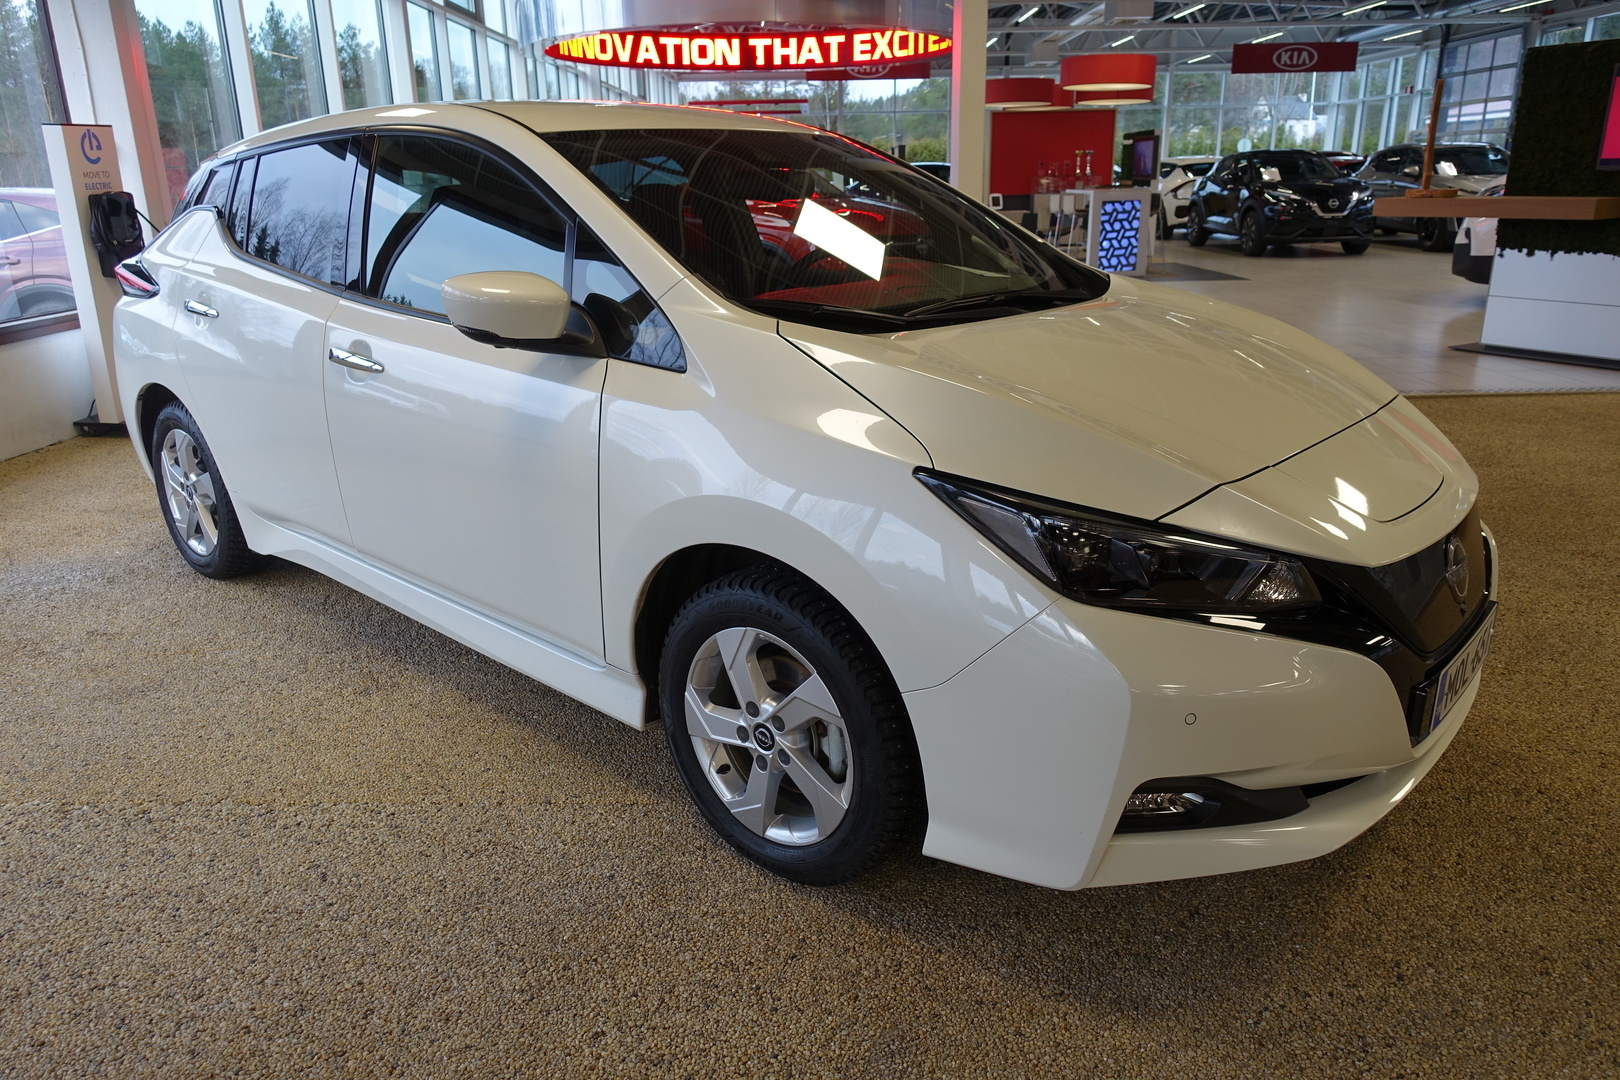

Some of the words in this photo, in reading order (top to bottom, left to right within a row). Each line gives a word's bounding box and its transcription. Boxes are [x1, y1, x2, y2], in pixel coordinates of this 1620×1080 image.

[559, 31, 740, 66] INNOVATION
[749, 35, 846, 66] THAT
[1281, 51, 1310, 65] KIA
[83, 171, 100, 179] MOVE
[101, 171, 110, 179] TO
[85, 182, 112, 191] ELECTRIC
